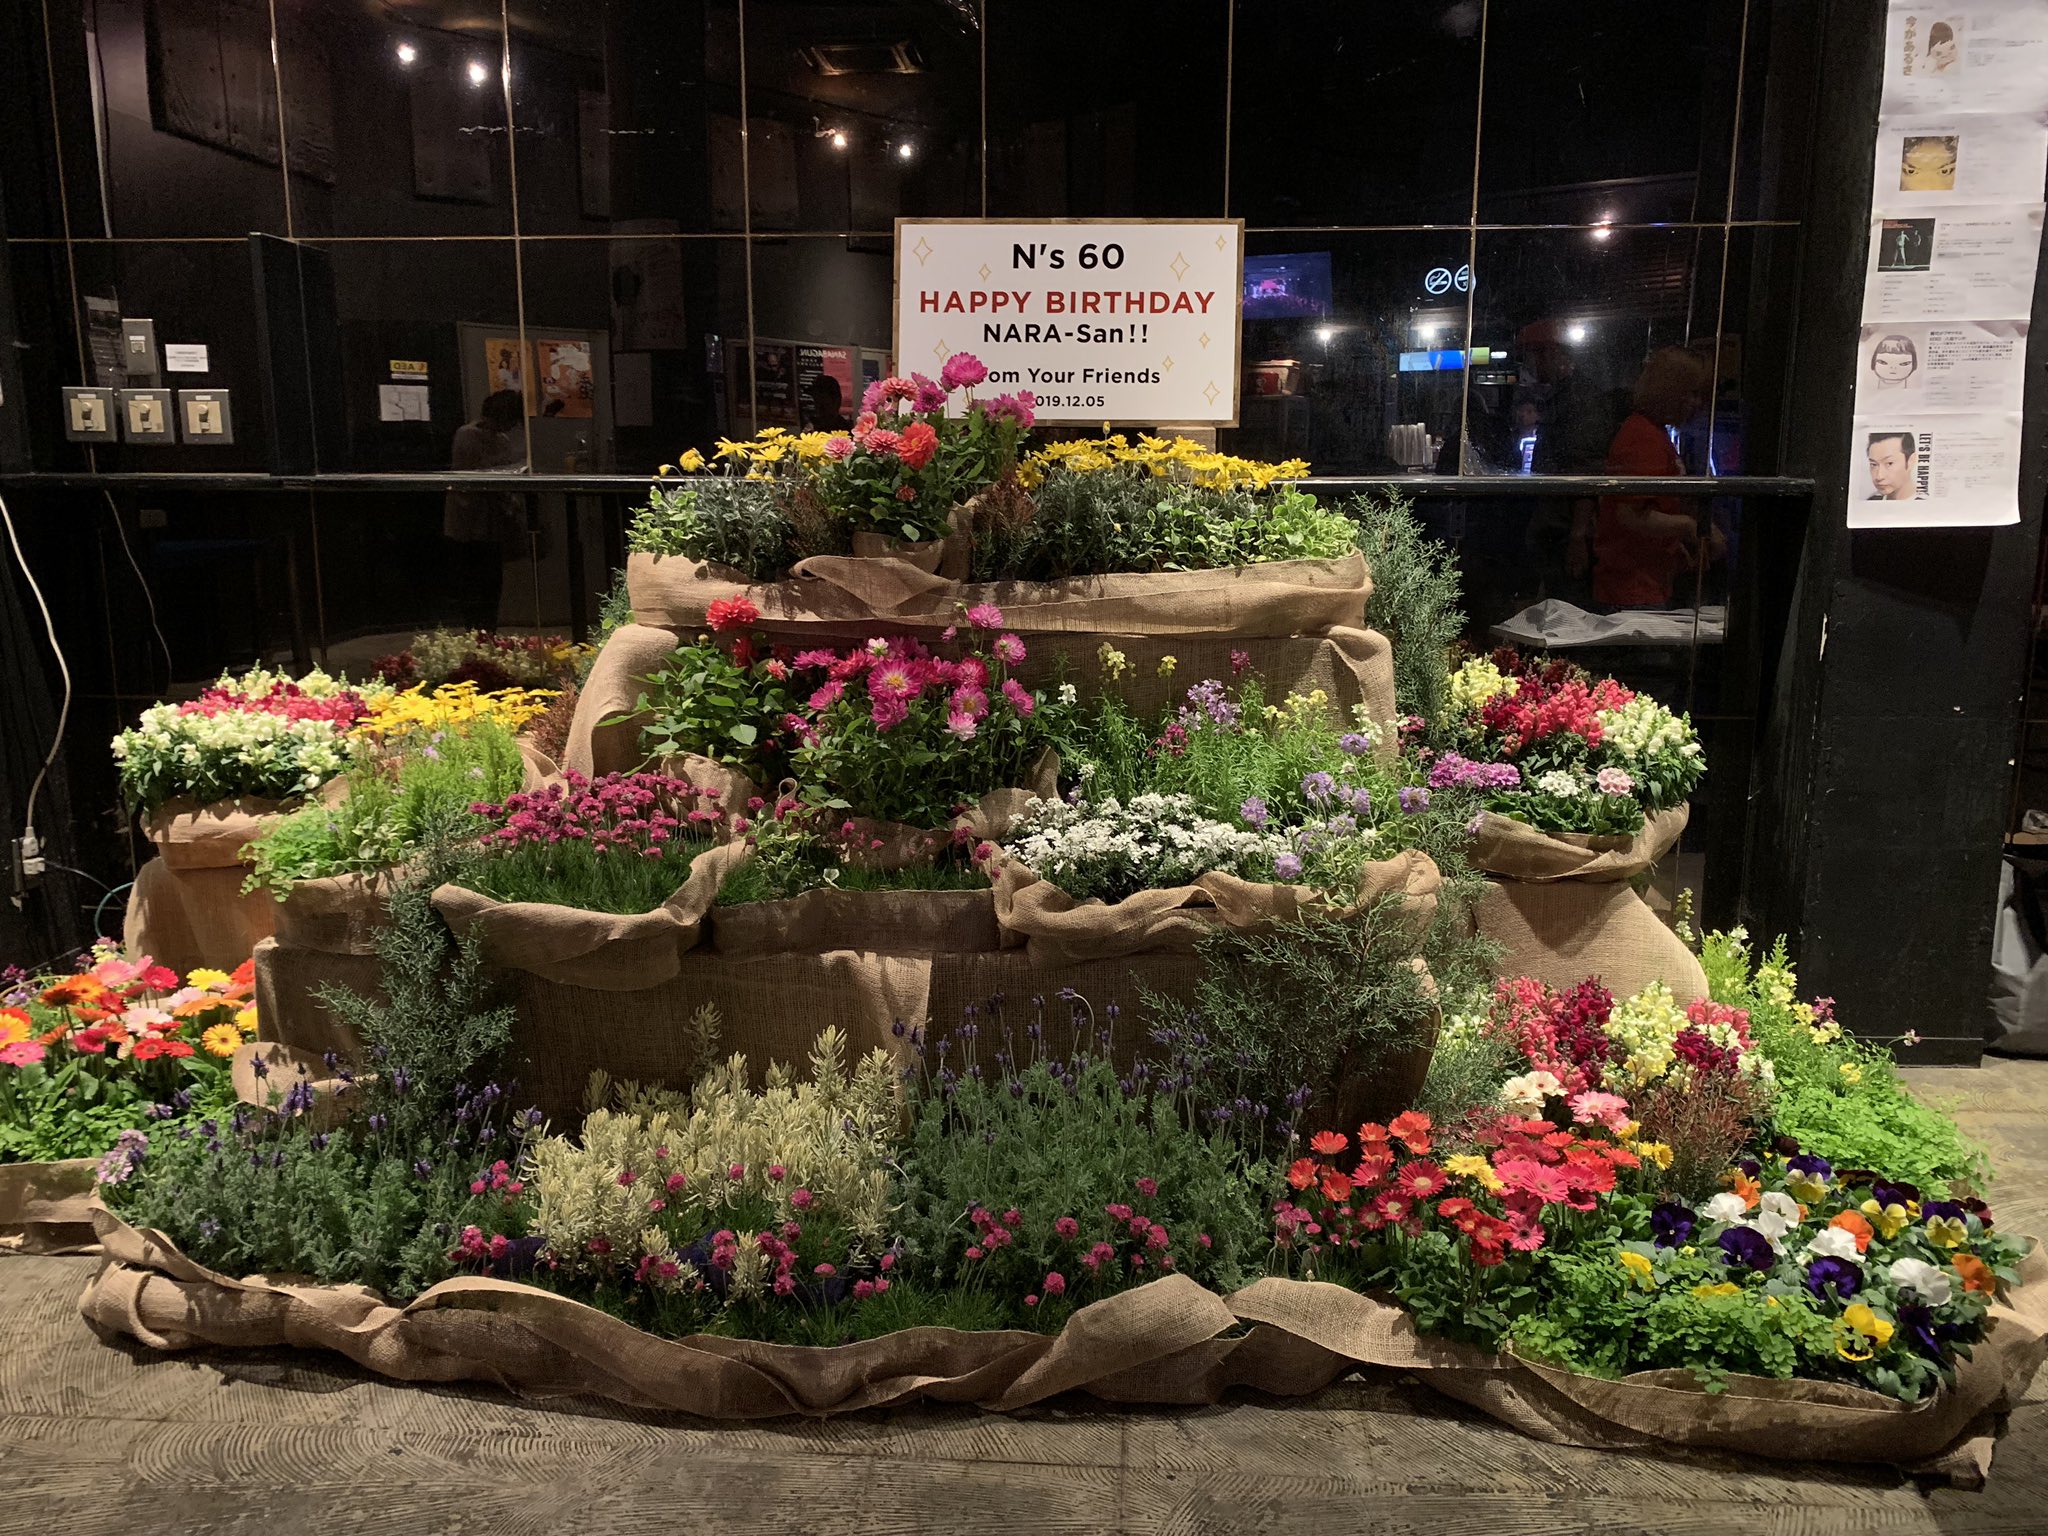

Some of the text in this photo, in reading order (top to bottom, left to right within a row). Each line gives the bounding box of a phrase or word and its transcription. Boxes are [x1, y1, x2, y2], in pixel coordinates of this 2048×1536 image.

[1012, 243, 1125, 270] N's 60
[920, 291, 1215, 314] HAPPY BIRTHDAY
[1027, 367, 1076, 384] Your
[1082, 367, 1161, 384] Friends
[1035, 395, 1105, 407] 019.12.05
[1919, 433, 1932, 452] LET'S
[1917, 454, 1930, 463] BE
